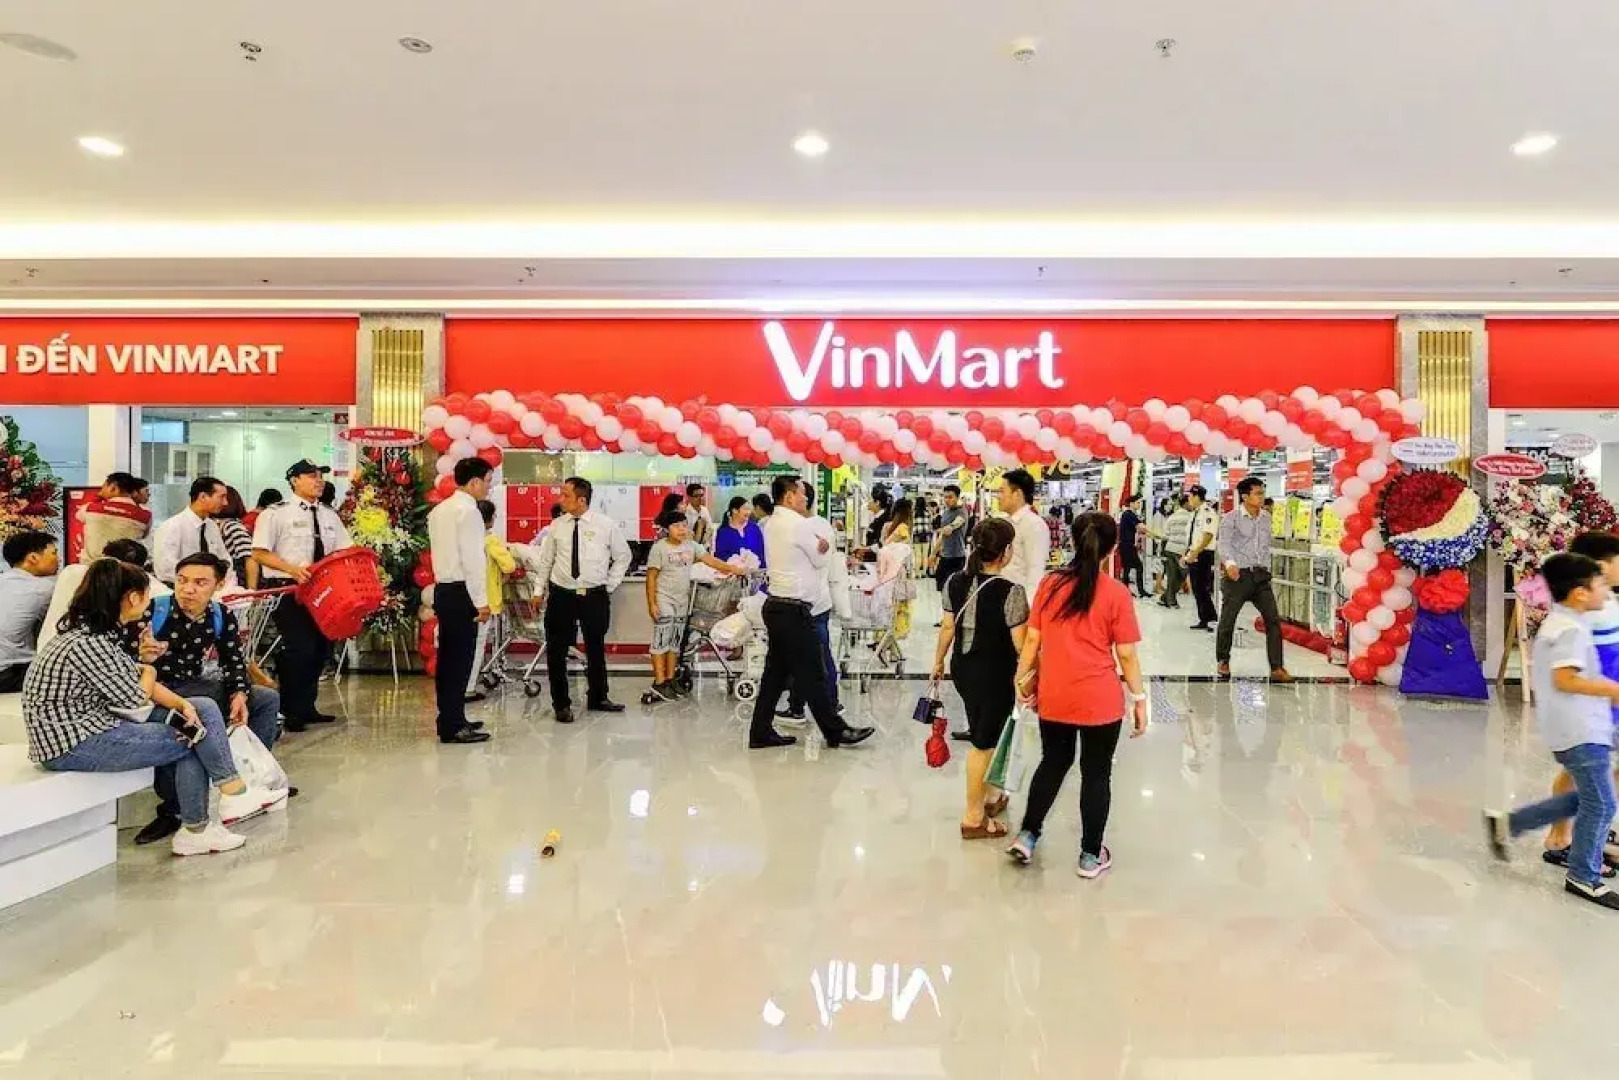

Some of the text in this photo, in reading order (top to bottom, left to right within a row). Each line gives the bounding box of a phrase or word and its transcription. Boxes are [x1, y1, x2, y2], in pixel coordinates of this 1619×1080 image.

[15, 331, 98, 375] ĐẾN
[104, 343, 285, 375] VINMART
[763, 320, 1065, 401] VinMart
